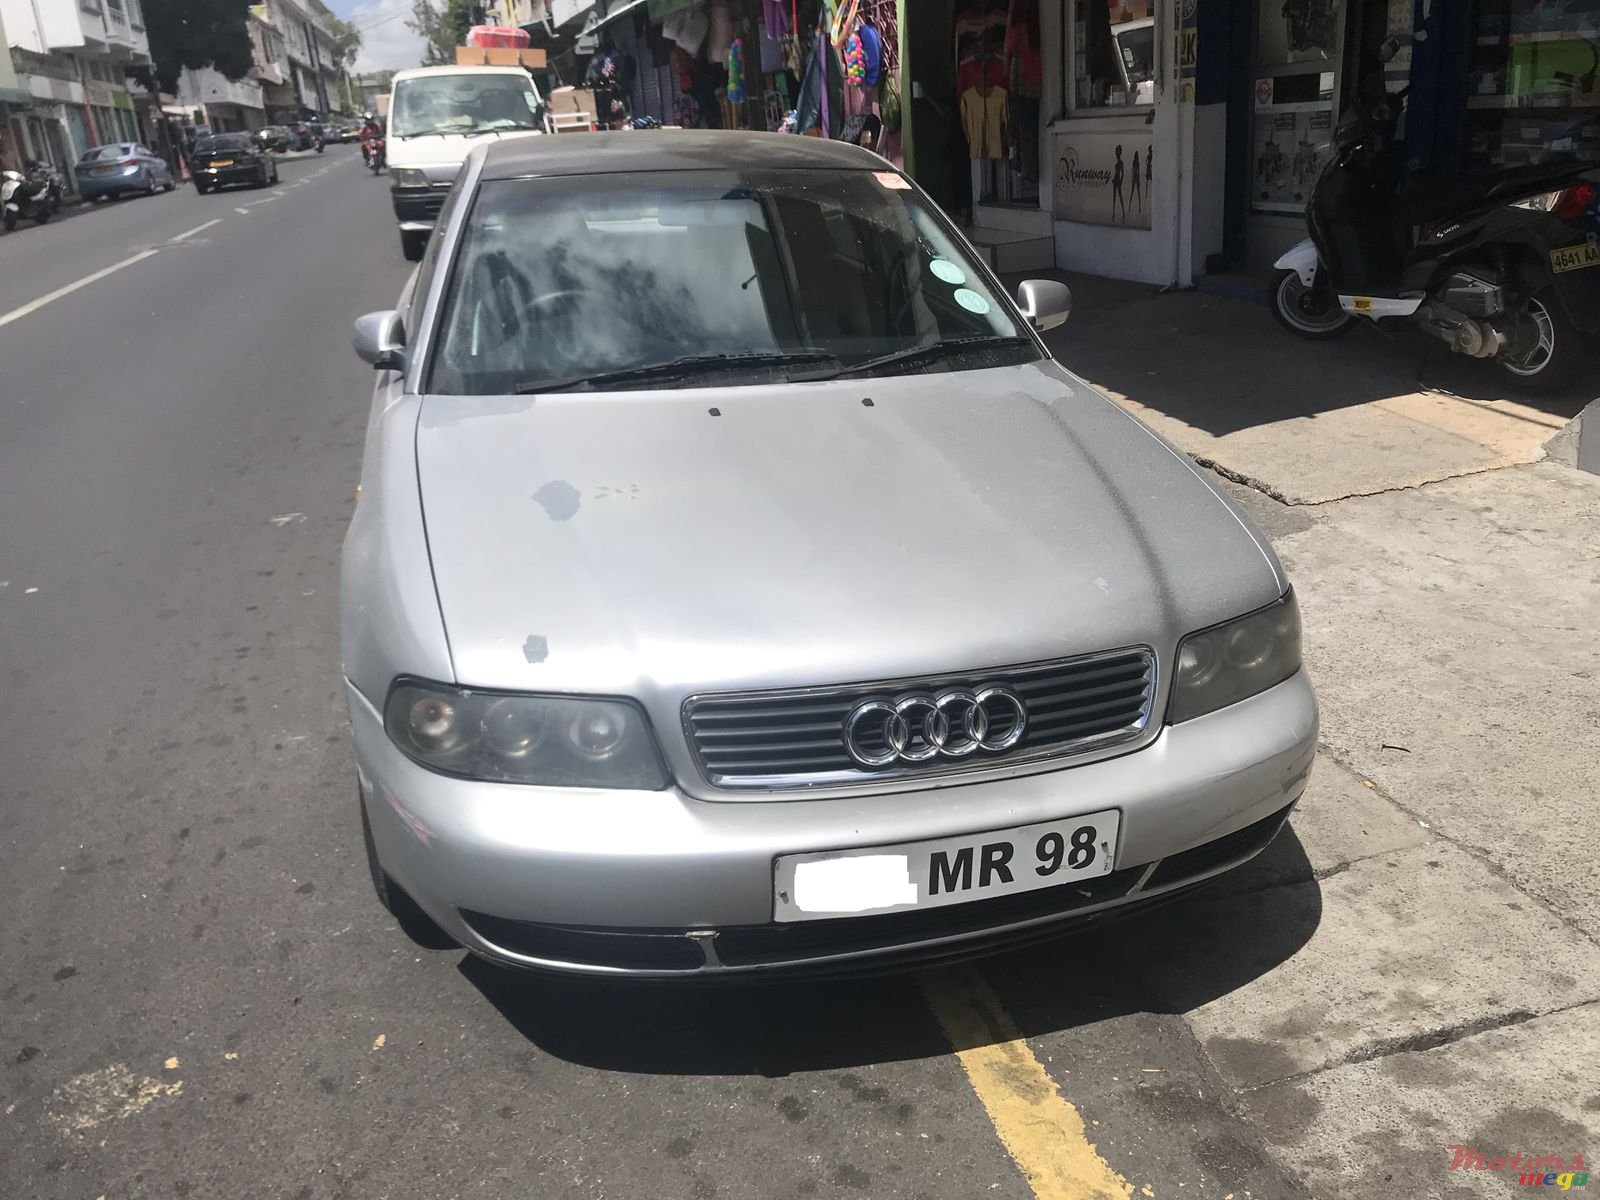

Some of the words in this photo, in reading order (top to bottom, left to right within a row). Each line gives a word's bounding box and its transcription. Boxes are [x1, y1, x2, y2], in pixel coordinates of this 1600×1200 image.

[1058, 156, 1112, 185] Runway
[1555, 251, 1581, 268] 4641
[928, 841, 1015, 896] MR
[1034, 825, 1098, 877] 98
